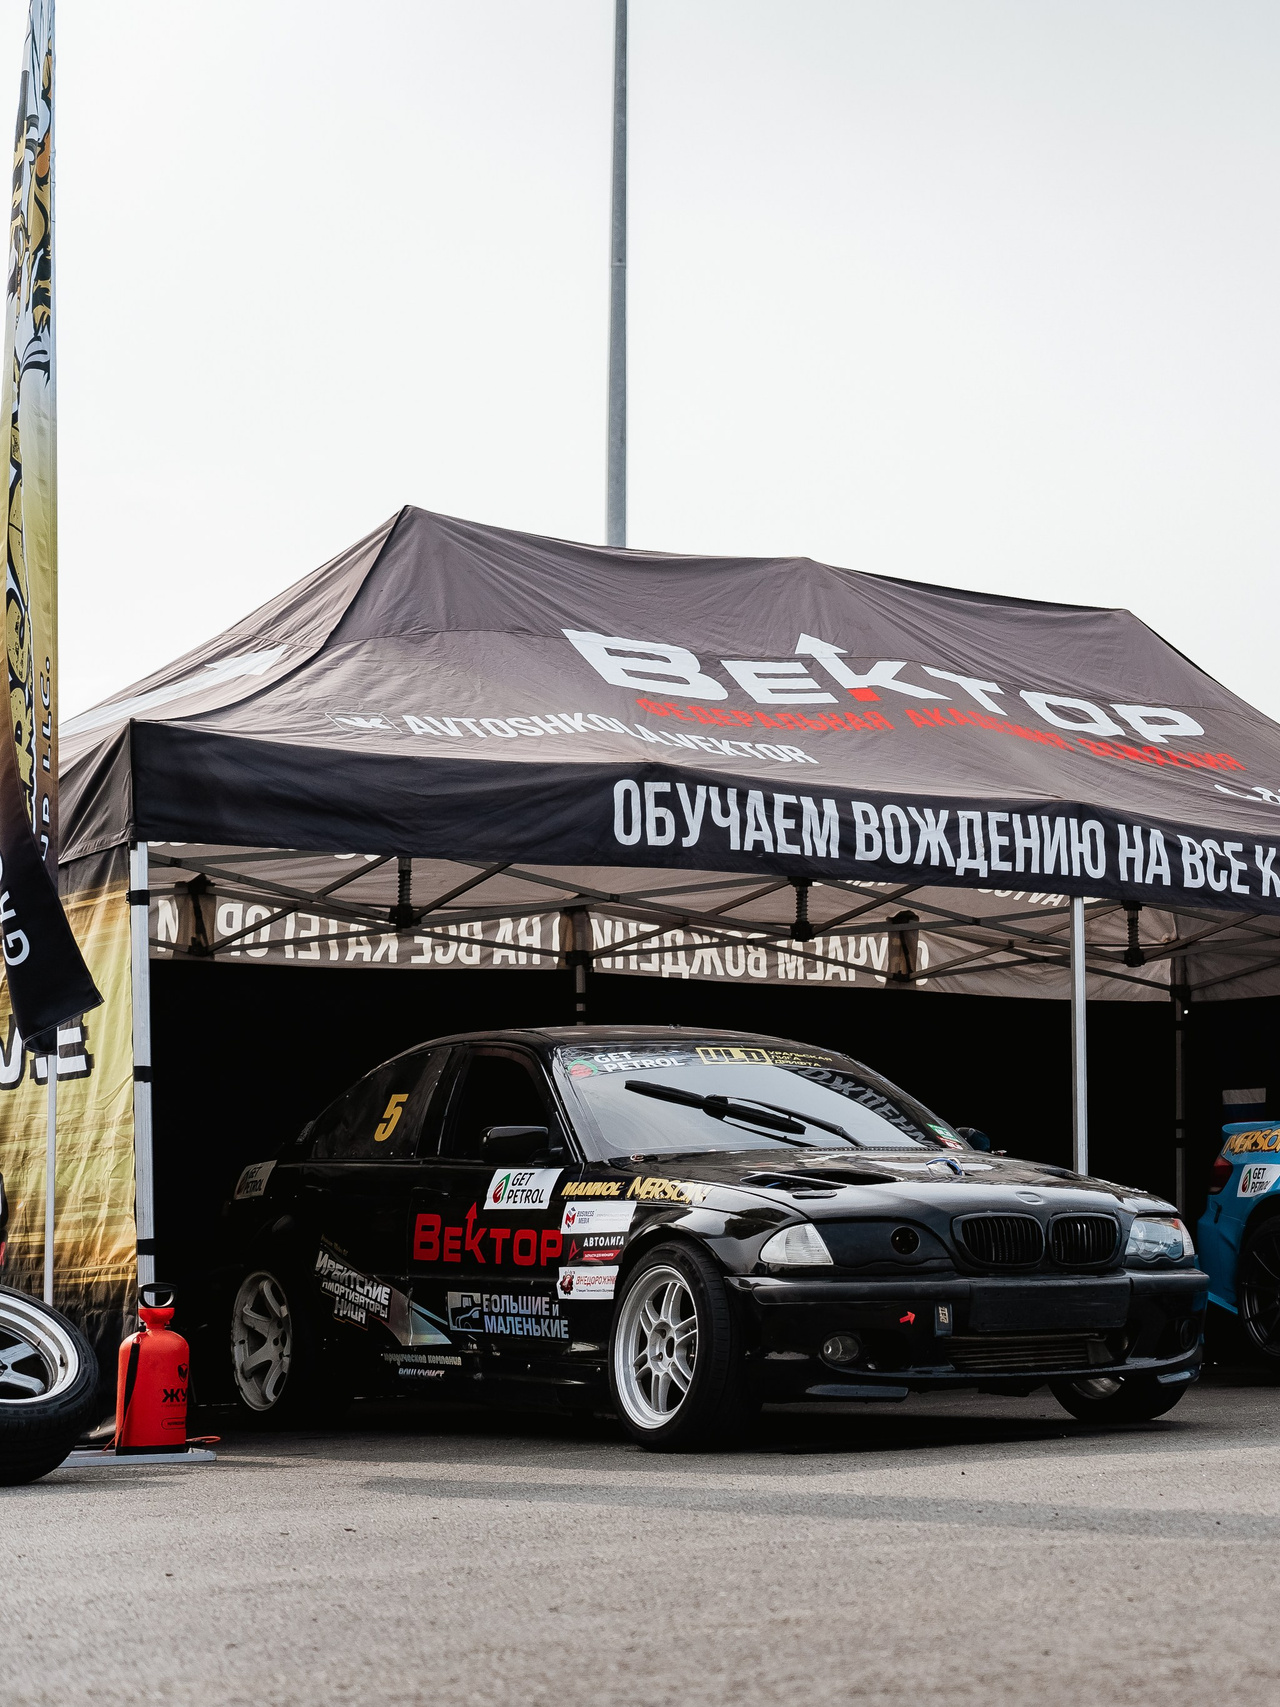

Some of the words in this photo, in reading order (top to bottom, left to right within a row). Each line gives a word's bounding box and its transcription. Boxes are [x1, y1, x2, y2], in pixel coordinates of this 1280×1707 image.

[637, 697, 895, 733] ФЕДЕРАЛЬНАЯ
[612, 778, 841, 859] ОБУЧАЕМ
[855, 800, 1105, 879] ВОЖДЕНИЮ
[1118, 824, 1171, 886] НА
[1181, 835, 1251, 895] ВСЕ
[594, 1051, 632, 1063] GET
[603, 1057, 686, 1073] PETROL
[374, 1093, 409, 1142] 5
[511, 1172, 535, 1187] GET
[1252, 1167, 1267, 1180] GET
[506, 1188, 545, 1204] PETROL
[561, 1181, 625, 1196] MANNOL
[583, 1236, 624, 1247] АВТОЛИГА
[576, 1275, 616, 1287] ВНЕДОРОЖНИ
[482, 1294, 550, 1316] БОЛЬШИЕ
[484, 1315, 569, 1339] МАЛЕНЬКИЕ
